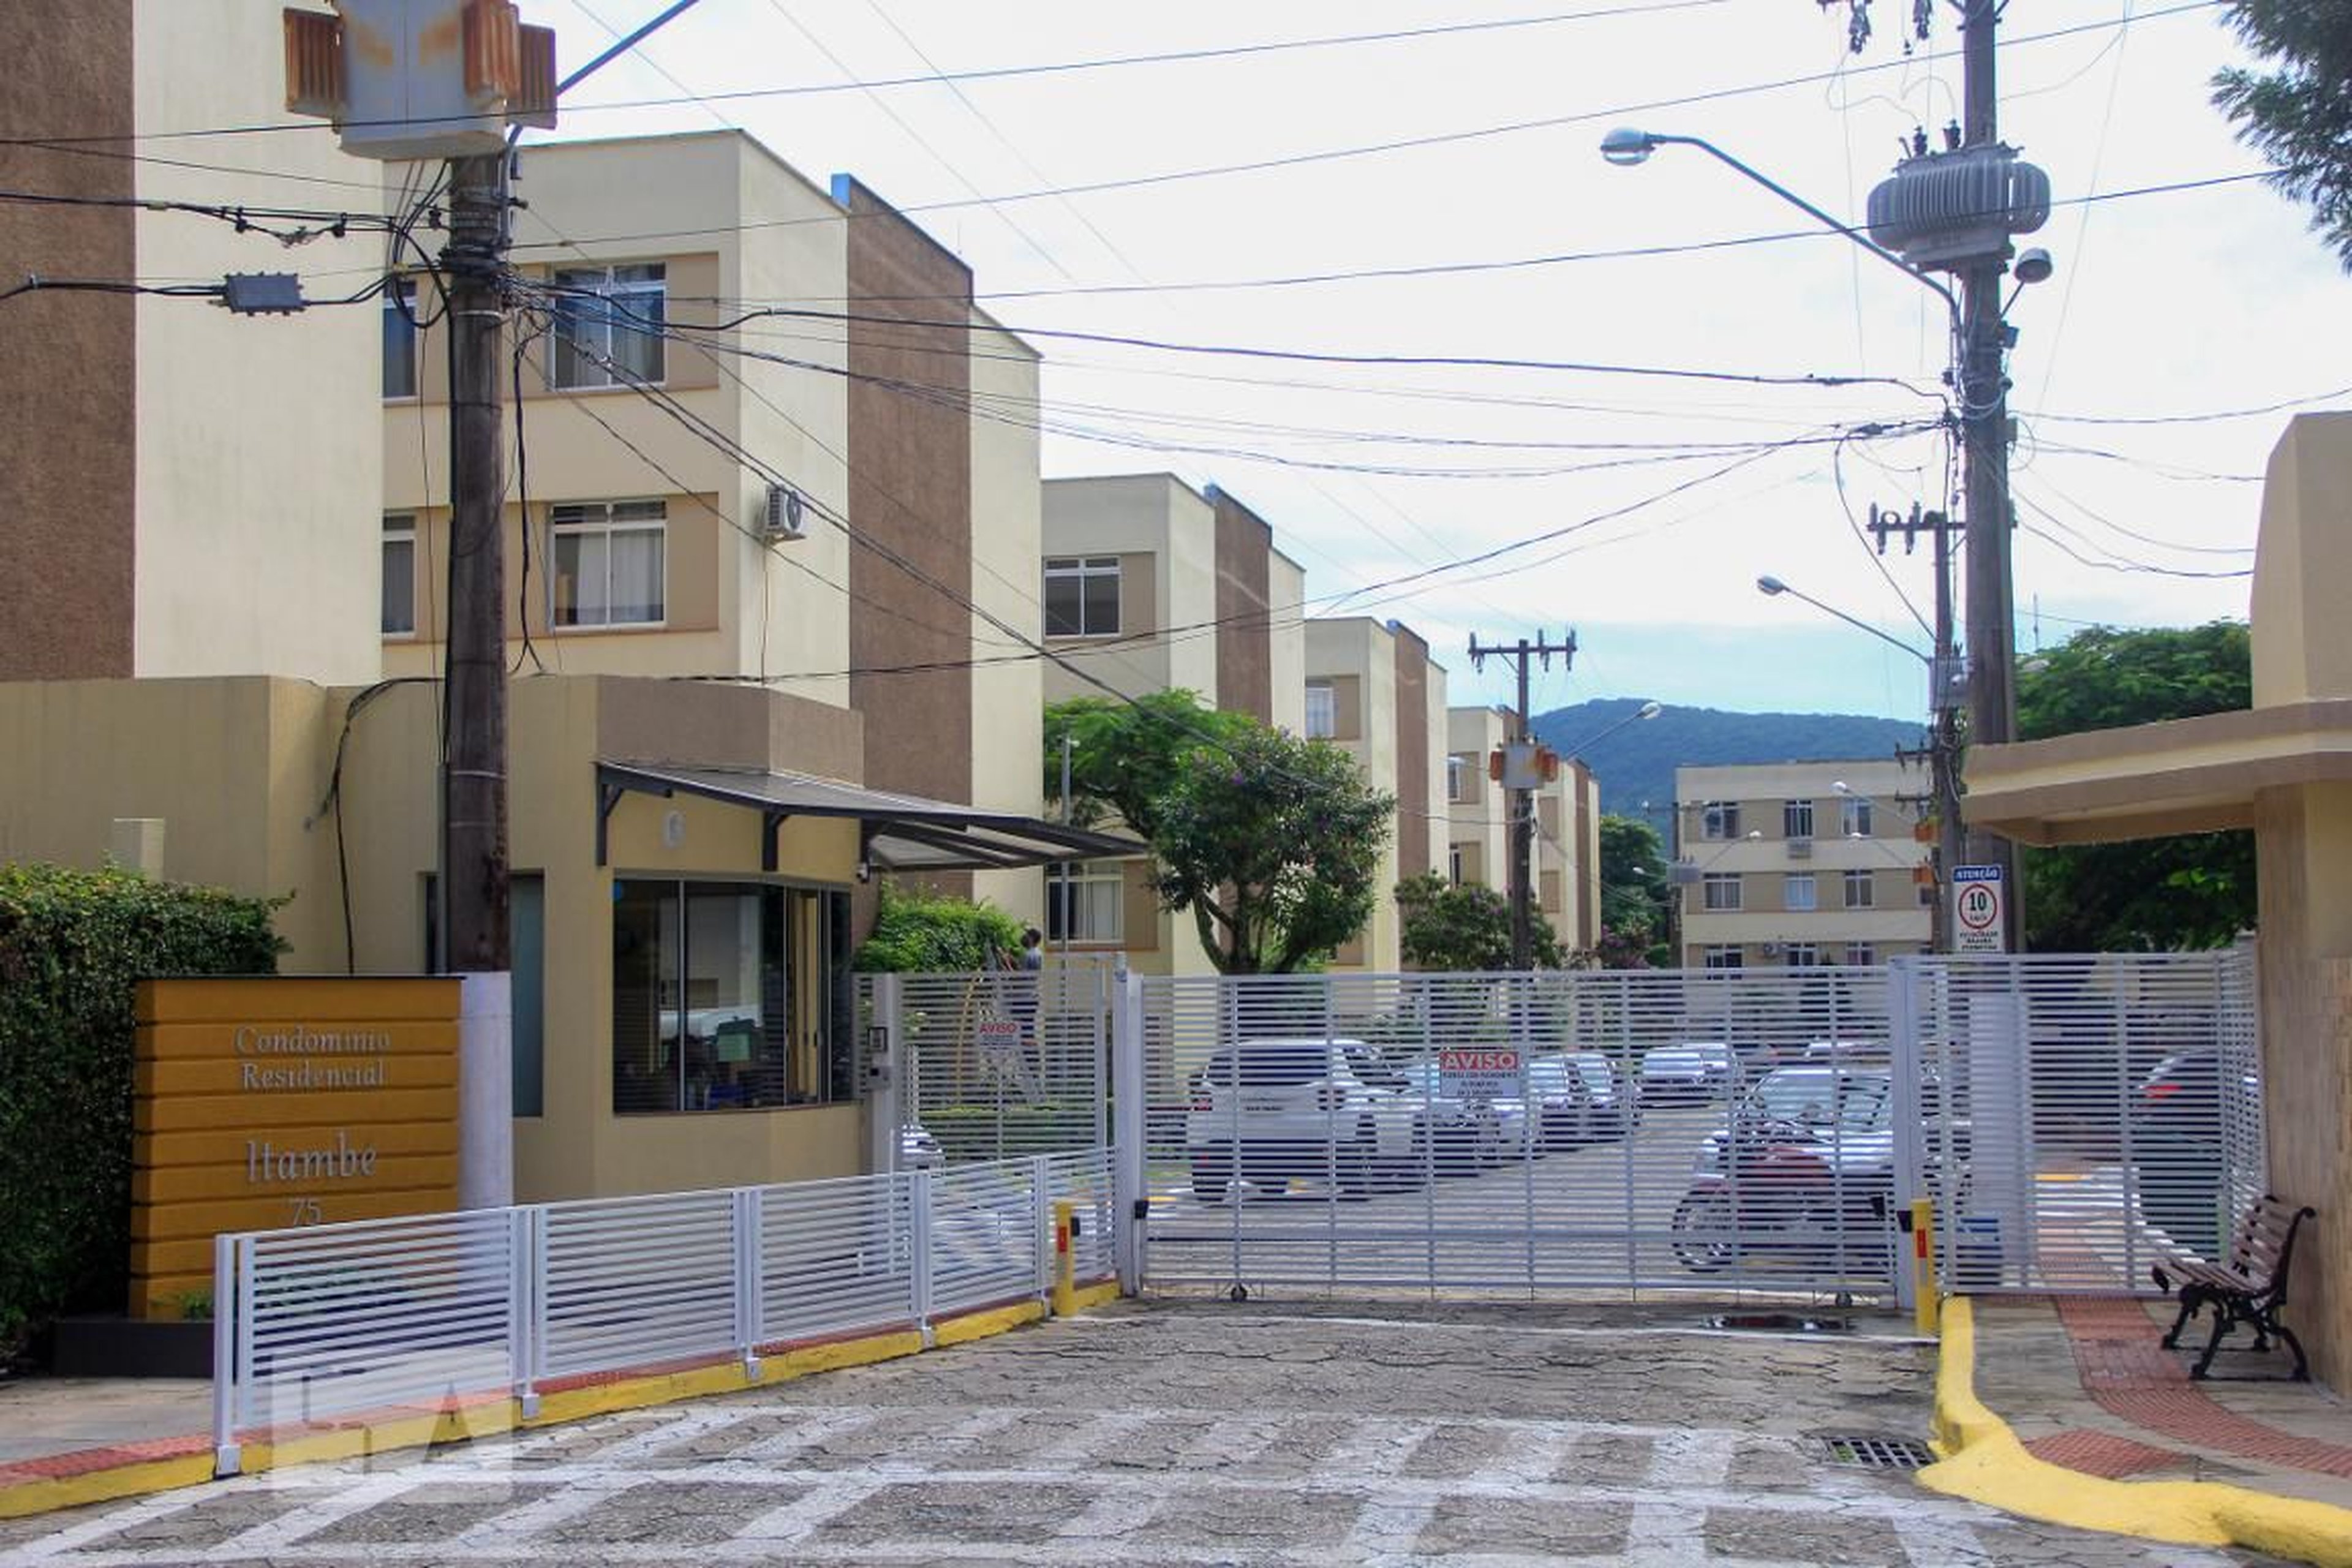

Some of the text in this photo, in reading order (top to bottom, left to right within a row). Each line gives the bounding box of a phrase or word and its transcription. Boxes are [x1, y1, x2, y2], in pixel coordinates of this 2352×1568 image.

[1969, 892, 1987, 911] 10
[1444, 1052, 1516, 1069] AVISO
[243, 1061, 385, 1089] Residencial
[292, 1197, 322, 1225] 75
